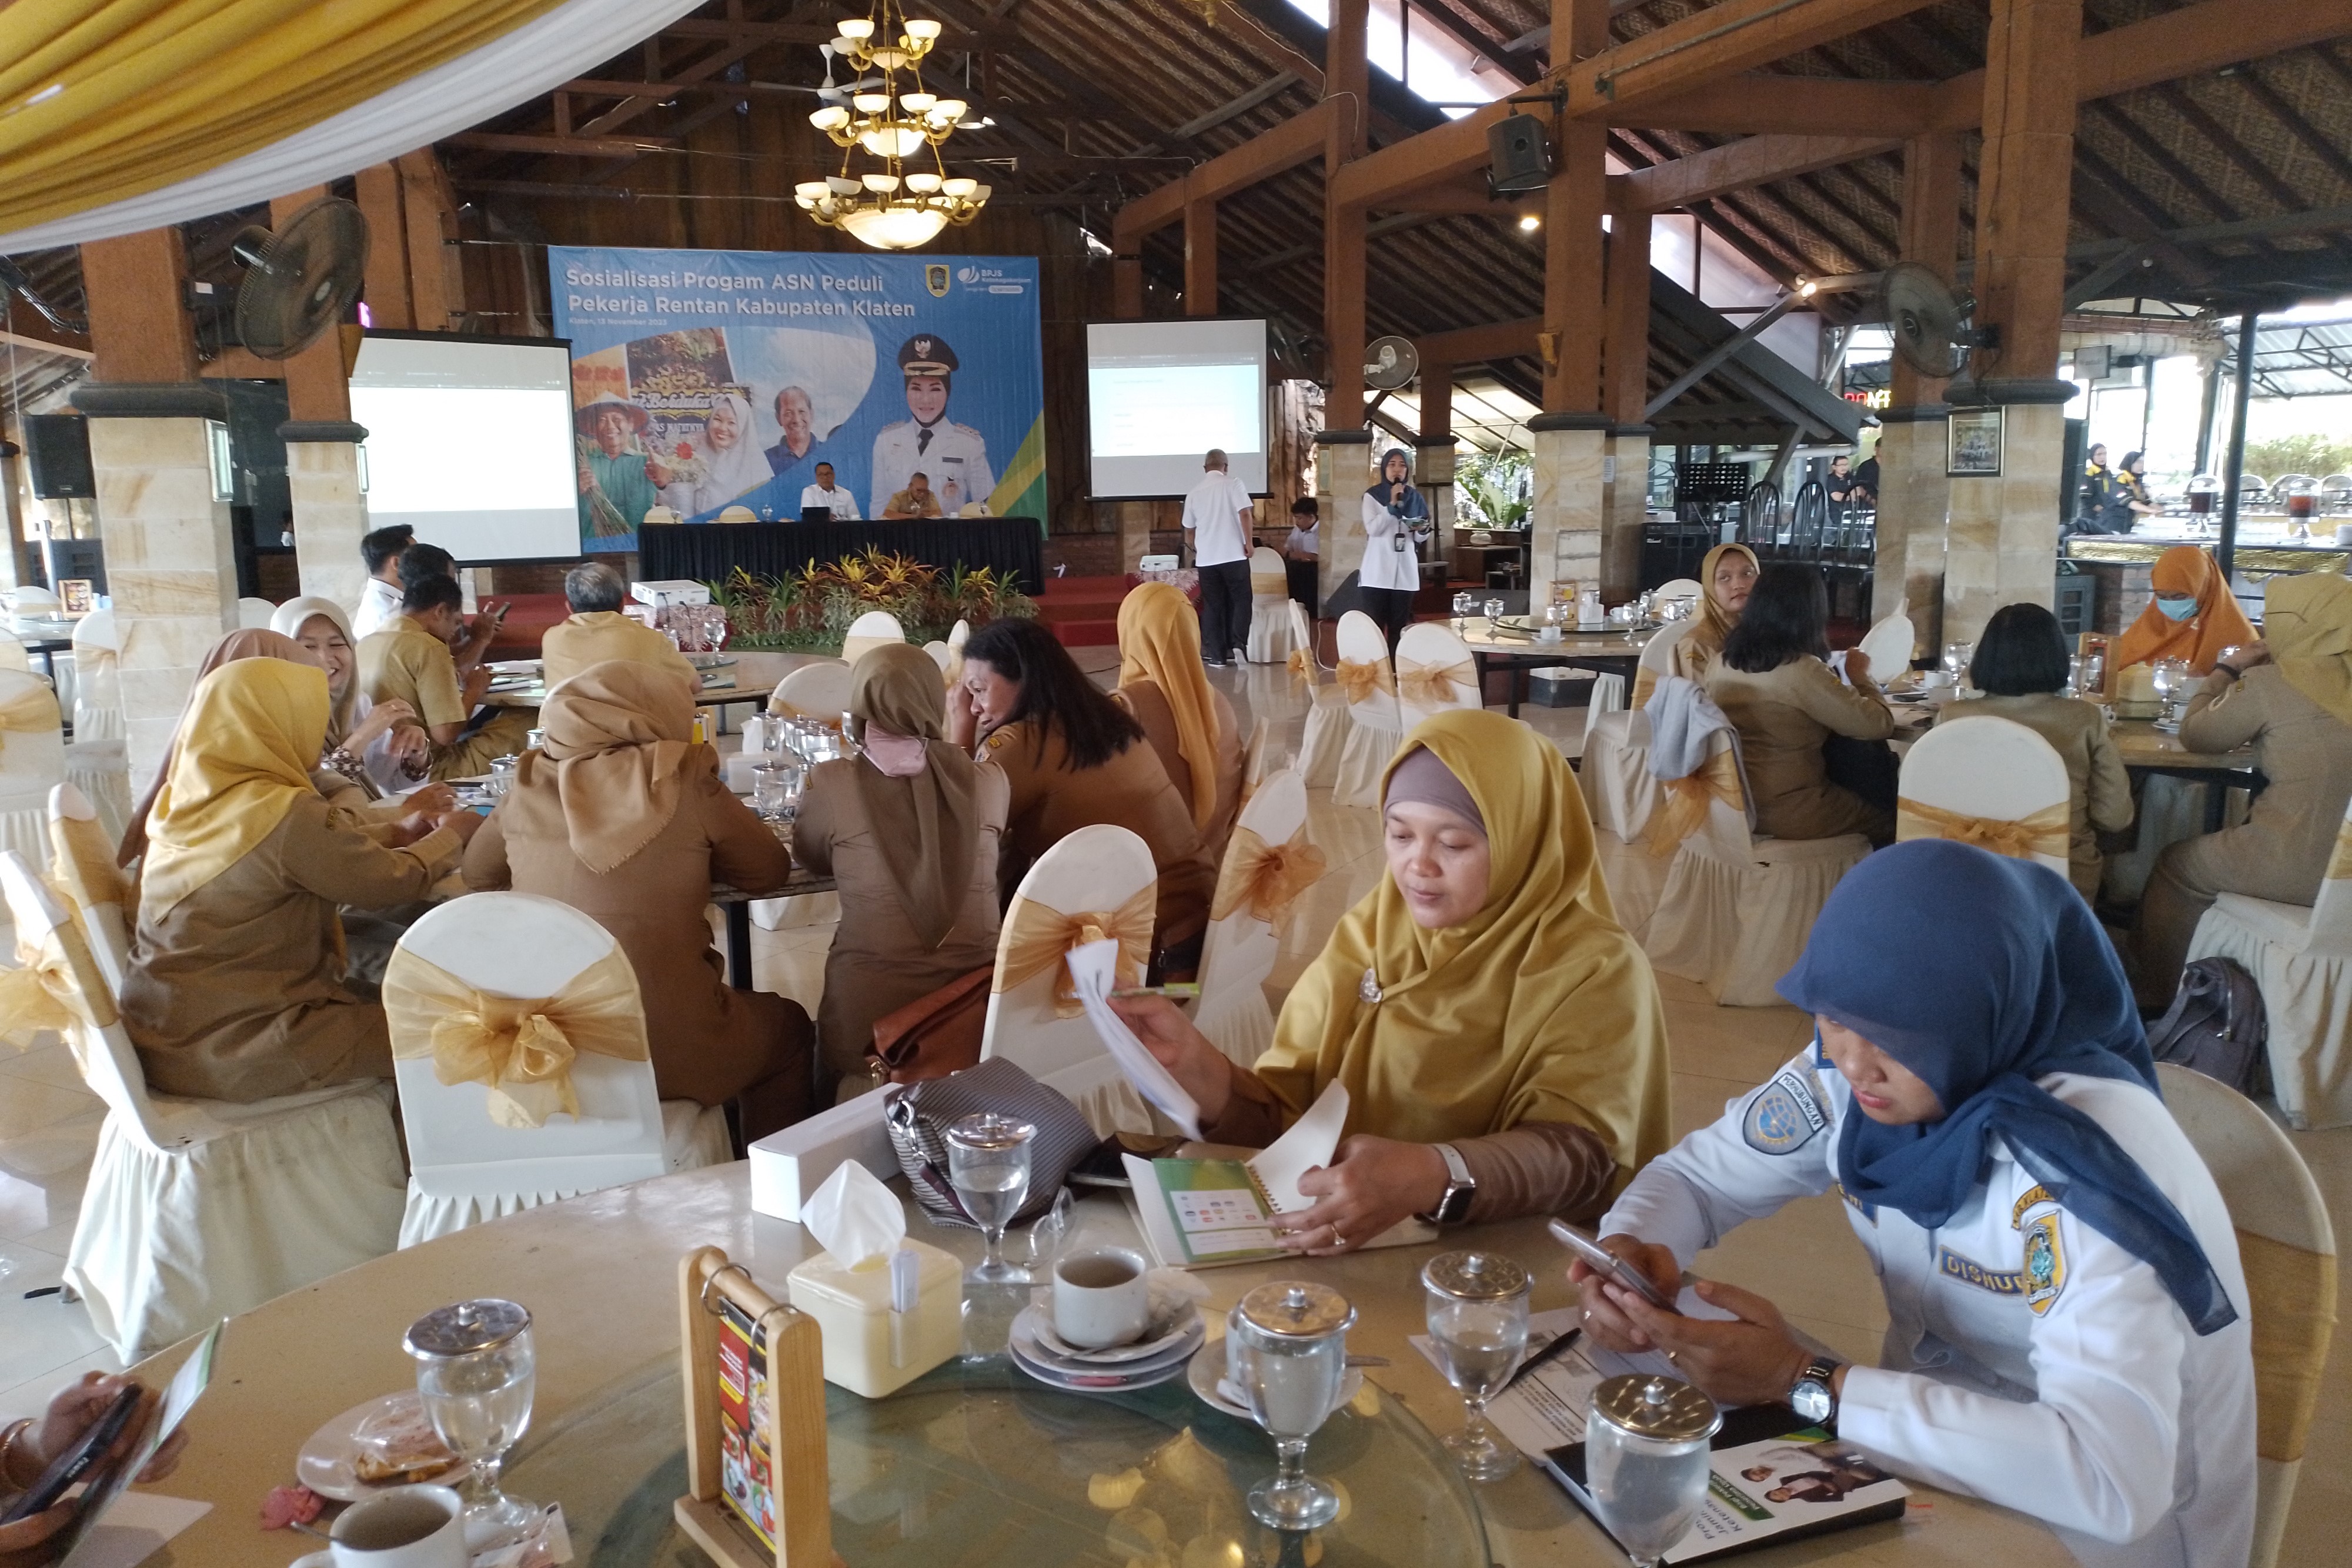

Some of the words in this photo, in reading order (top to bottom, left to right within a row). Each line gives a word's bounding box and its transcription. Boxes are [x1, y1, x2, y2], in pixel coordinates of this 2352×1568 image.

[566, 269, 677, 287] Sosialisasi
[683, 272, 764, 292] Progam
[771, 274, 815, 290] ASN
[821, 275, 883, 292] Peduli
[981, 269, 1003, 278] BPJS
[568, 295, 648, 316] Pekerja
[655, 296, 729, 314] Rentan
[735, 297, 846, 318] Kabupaten
[853, 300, 915, 317] Klaten
[1782, 1075, 1822, 1125] PERHUBUNGAN
